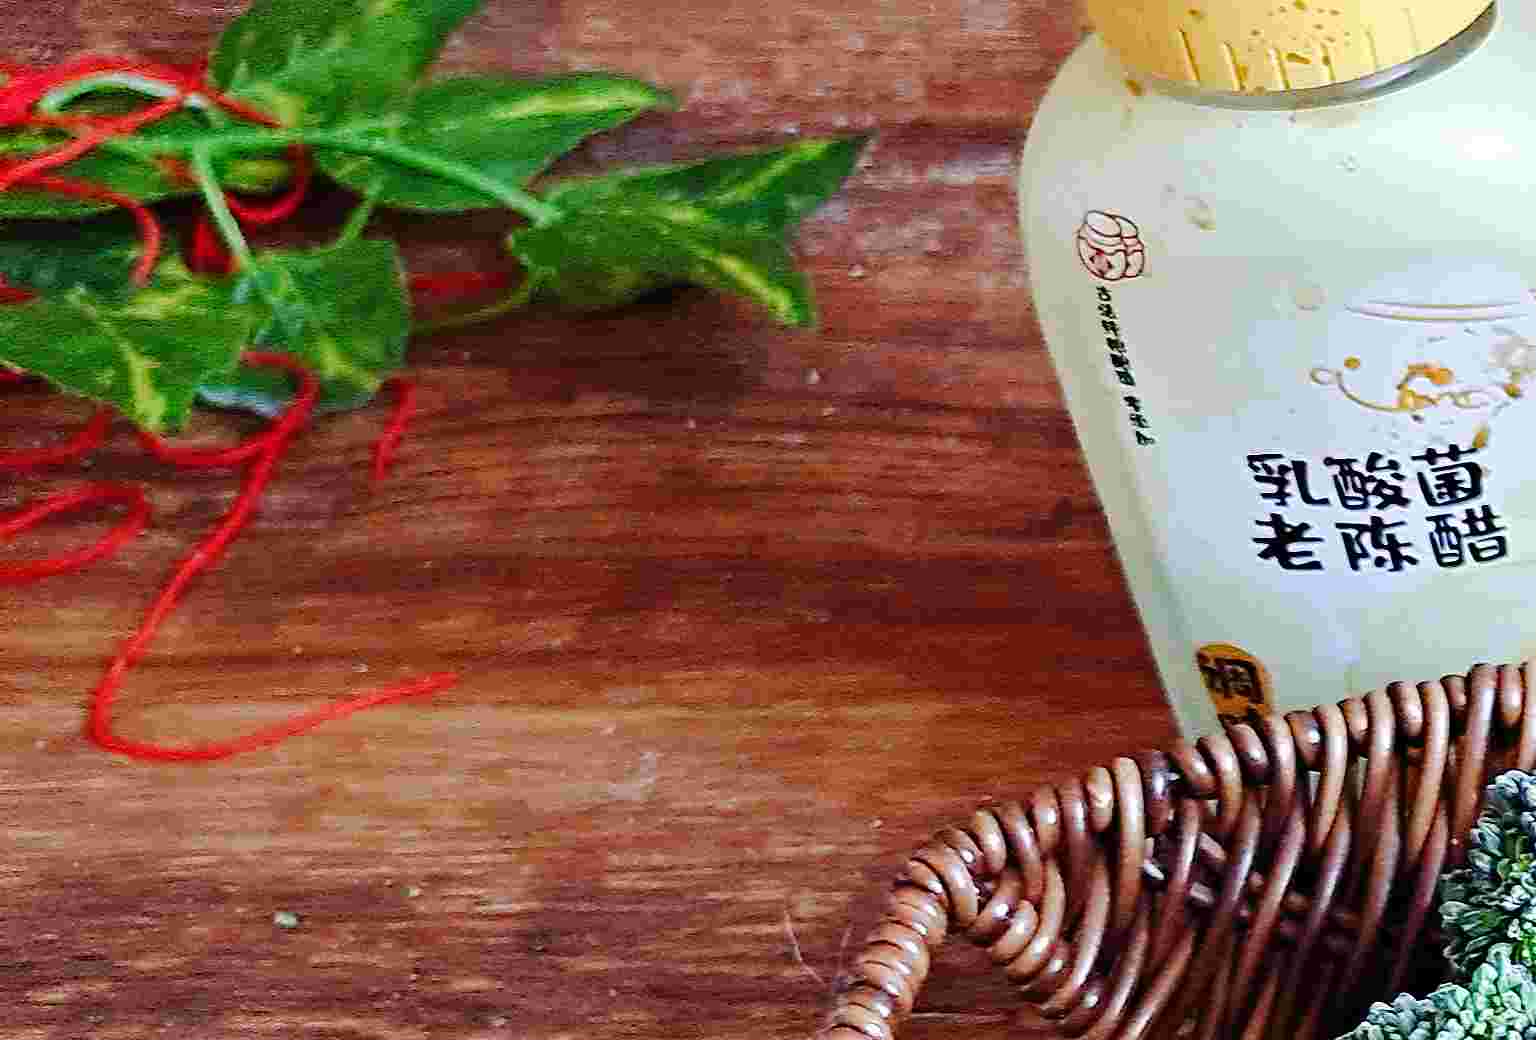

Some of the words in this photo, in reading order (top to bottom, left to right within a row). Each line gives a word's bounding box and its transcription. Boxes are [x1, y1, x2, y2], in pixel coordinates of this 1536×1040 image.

[1246, 444, 1483, 510] 乳酸菌
[1251, 505, 1508, 572] 老陈醋
